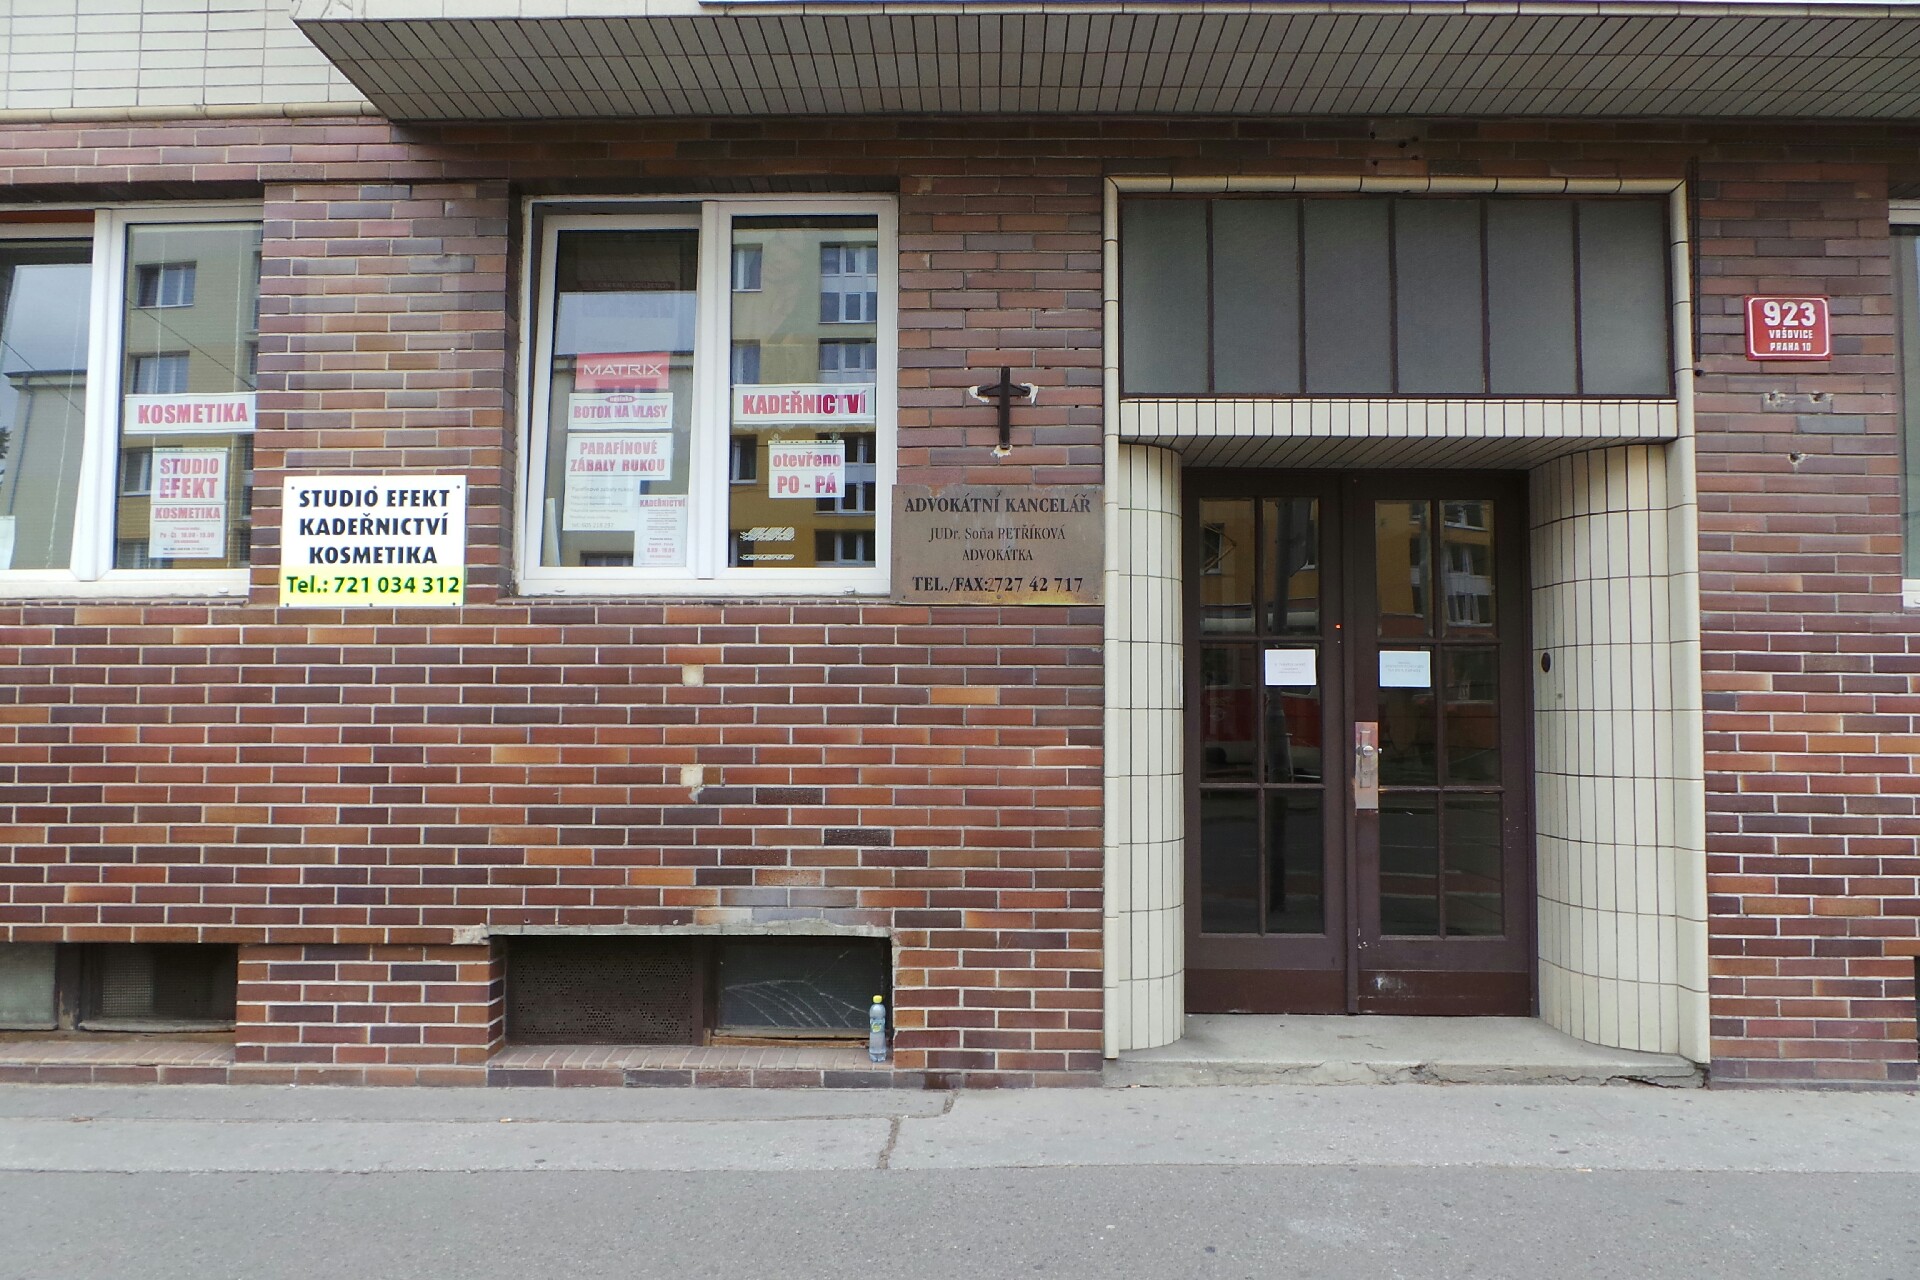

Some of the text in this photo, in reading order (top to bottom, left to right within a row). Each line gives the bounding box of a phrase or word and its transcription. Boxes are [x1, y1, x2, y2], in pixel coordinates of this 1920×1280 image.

[1763, 301, 1816, 326] 923
[1768, 327, 1813, 339] VRŠOVICE
[1770, 342, 1811, 351] PRAHA 10
[583, 363, 663, 376] MATRIX
[742, 389, 867, 415] KADEŘNICTVÍ
[137, 402, 248, 425] KOSMETIKA
[573, 404, 668, 419] BOTOX NA VLASY
[579, 439, 658, 455] PARAFÍNOVÉ
[159, 457, 219, 475] STUDIO
[569, 456, 666, 472] ZÁBALY RUKOU
[772, 451, 842, 468] otevřeno
[159, 477, 218, 499] EFEKT
[777, 475, 800, 494] PO
[814, 472, 838, 494] PÁ
[298, 488, 451, 508] STUDIO EFEKT
[904, 492, 1091, 513] ADVOKÁTNÍ KANCELÁŘ
[154, 507, 221, 519] KOSMETIKA
[298, 512, 449, 536] KADEŘNICTVÍ
[928, 523, 1066, 543] JUDr. Soňa PETŘÍKOVÁ
[308, 545, 438, 565] KOSMETIKA
[962, 545, 1034, 561] ADVOKÁTKA
[286, 574, 460, 593] Tel.: 721 034 312
[1029, 576, 1048, 592] 42
[1054, 577, 1083, 593] 717
